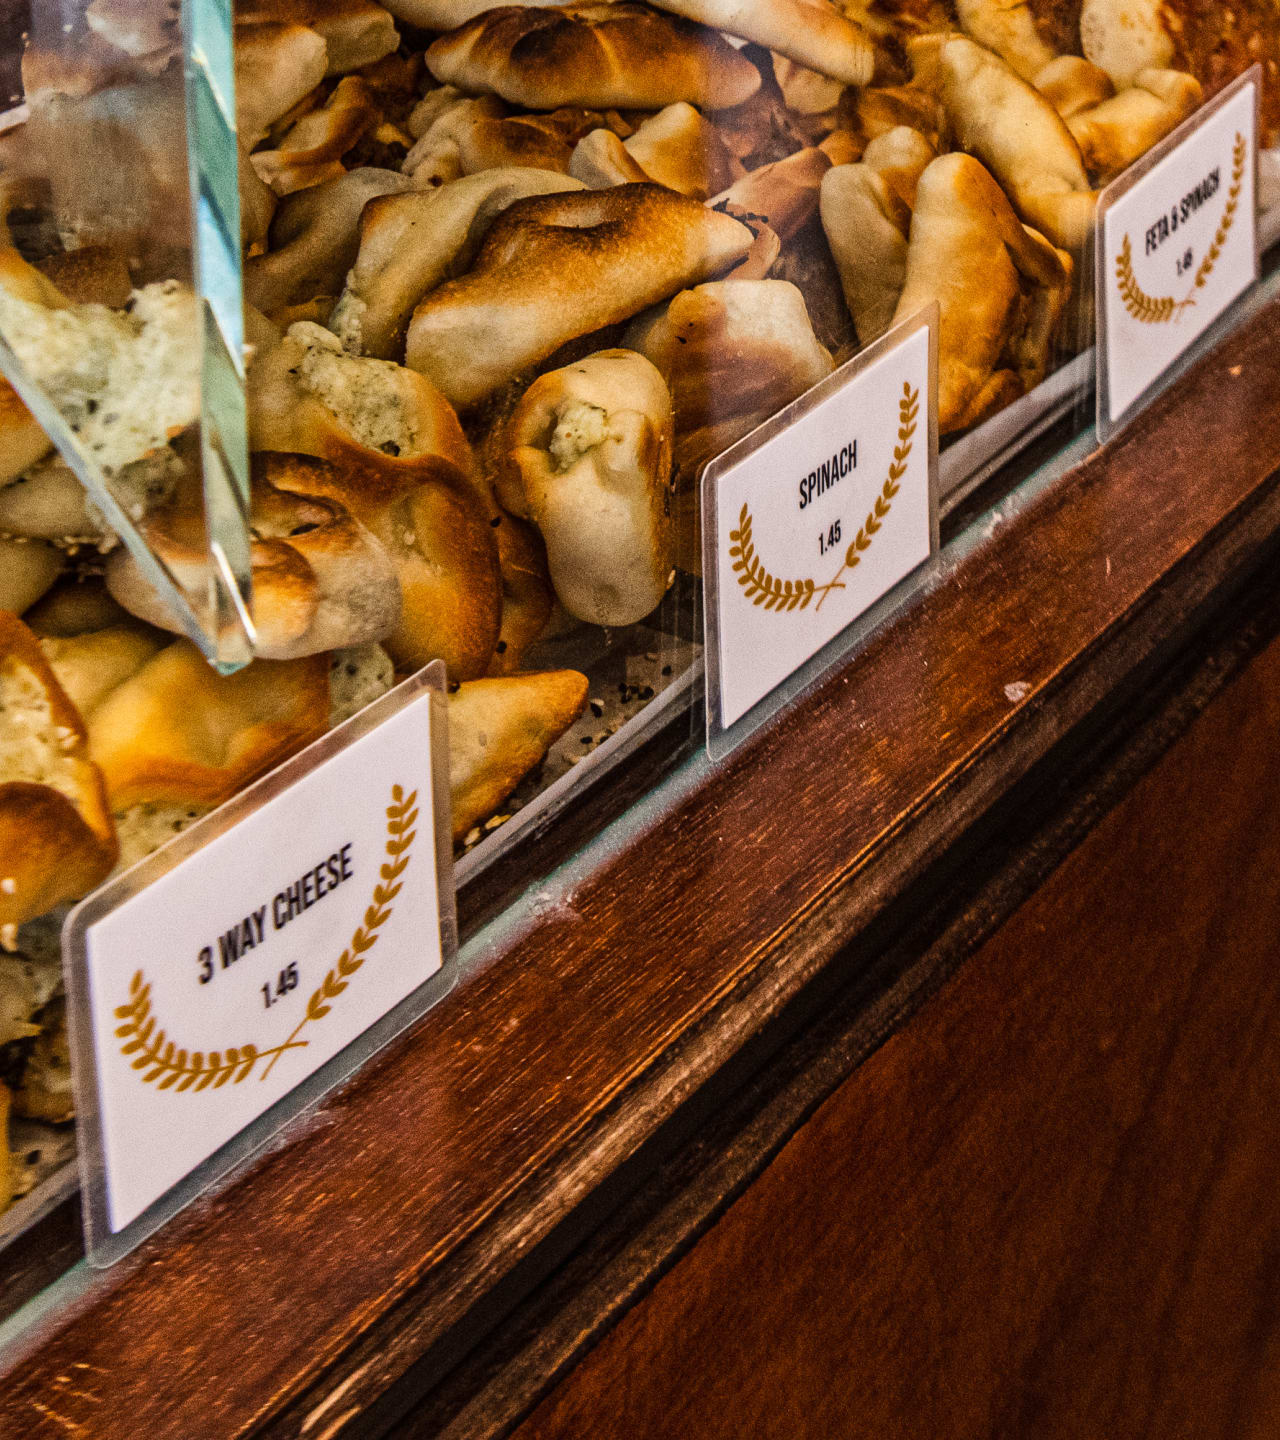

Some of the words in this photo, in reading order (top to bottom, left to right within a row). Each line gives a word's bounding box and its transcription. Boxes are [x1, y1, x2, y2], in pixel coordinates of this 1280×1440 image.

[1145, 215, 1169, 256] FETA
[1180, 167, 1220, 223] SPINACH
[799, 439, 857, 509] SPINACH
[818, 520, 841, 556] 1.45
[197, 945, 214, 984] 3
[217, 905, 267, 969] WAY
[273, 842, 353, 930] CHEESE
[261, 961, 299, 1008] 1.45
